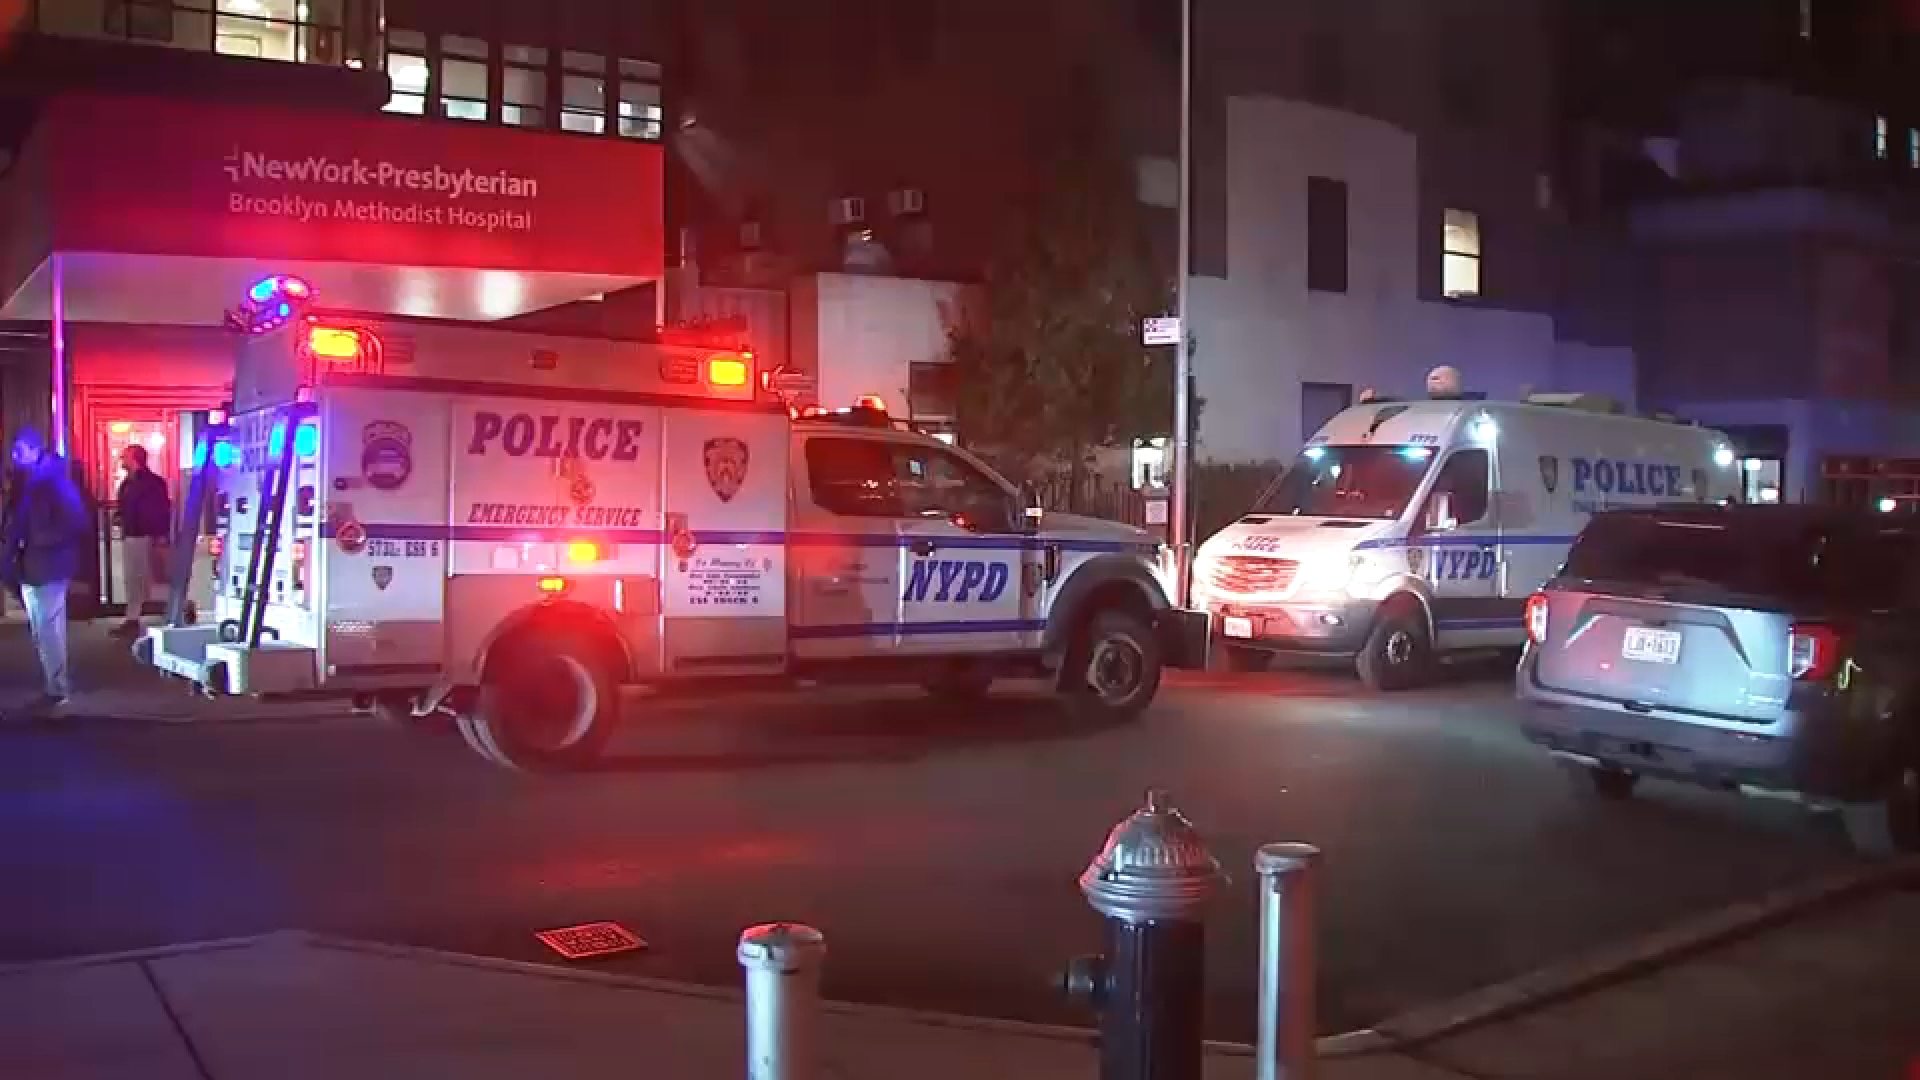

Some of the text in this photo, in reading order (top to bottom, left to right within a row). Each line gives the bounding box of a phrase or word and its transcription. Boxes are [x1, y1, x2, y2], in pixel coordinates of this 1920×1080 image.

[243, 151, 538, 198] NewYork-Presbyterian
[229, 192, 532, 232] Brooklyn Methodist Hospital
[467, 411, 644, 462] POLICE
[1571, 456, 1682, 497] POLICE
[467, 503, 643, 528] EMERGENCY SERVICE
[903, 559, 1009, 603] NYPD
